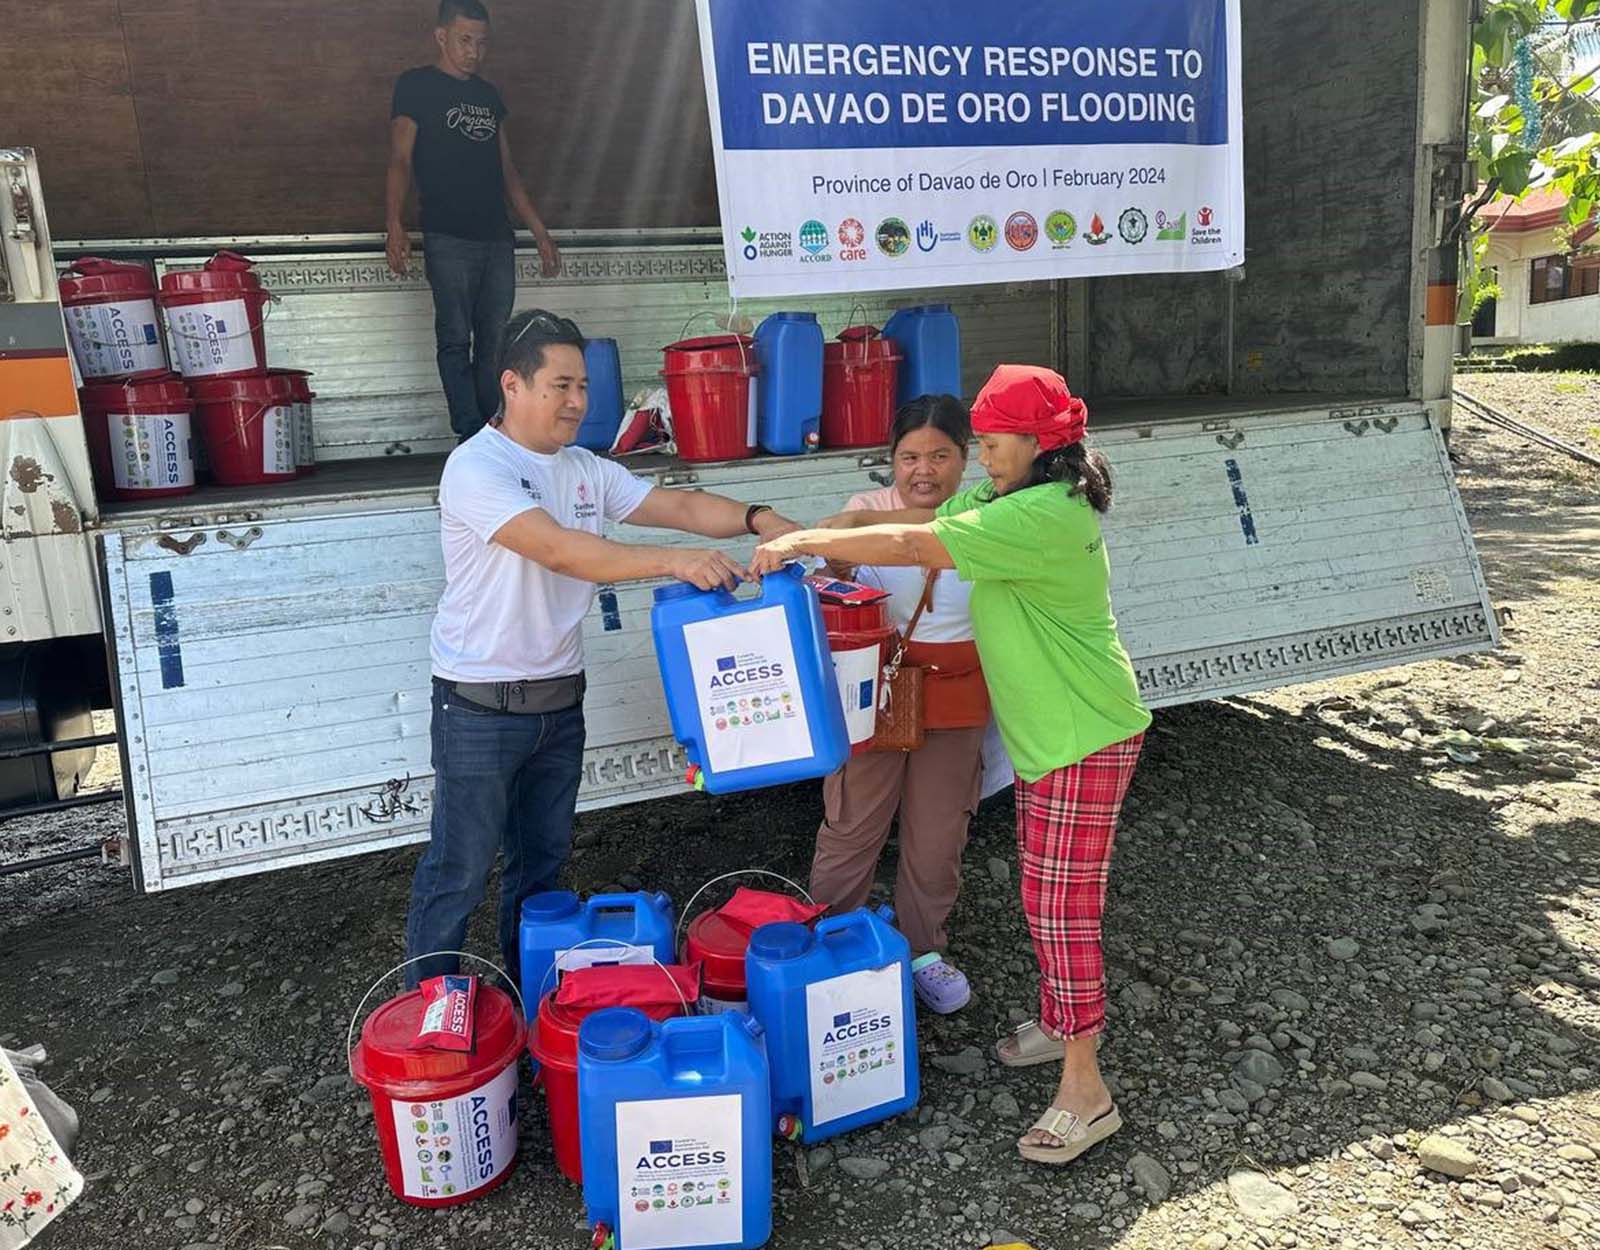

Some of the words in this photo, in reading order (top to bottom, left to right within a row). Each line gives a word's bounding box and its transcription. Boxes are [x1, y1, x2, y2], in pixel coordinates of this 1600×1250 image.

[747, 42, 973, 76] EMERGENCY
[984, 46, 1158, 77] RESPONSE
[1165, 49, 1202, 79] TO
[762, 92, 890, 124] DAVAO
[901, 93, 948, 123] DE
[957, 92, 1031, 123] ORO
[1041, 92, 1195, 123] FLOODING
[812, 174, 891, 194] Province
[897, 173, 913, 191] of
[919, 173, 975, 191] Davao
[980, 172, 1001, 189] de
[1006, 170, 1038, 188] Oro
[1053, 169, 1124, 189] February
[1128, 167, 1166, 185] 2024
[758, 232, 793, 242] ACTION
[1191, 228, 1207, 237] Save
[1209, 226, 1222, 236] the
[1191, 236, 1223, 246] Children
[759, 241, 793, 250] AGAINST
[759, 249, 794, 259] HUNGER
[800, 253, 832, 264] ACCORD
[839, 248, 867, 262] care
[109, 306, 135, 370] ACCESS
[202, 313, 224, 366] ACCESS
[164, 418, 179, 484] ACCESS
[709, 663, 784, 689] ACCESS
[450, 991, 469, 1034] ACCESS
[822, 1015, 892, 1045] ACCESS
[470, 1096, 494, 1180] ACCESS
[635, 1150, 727, 1170] ACCESS
